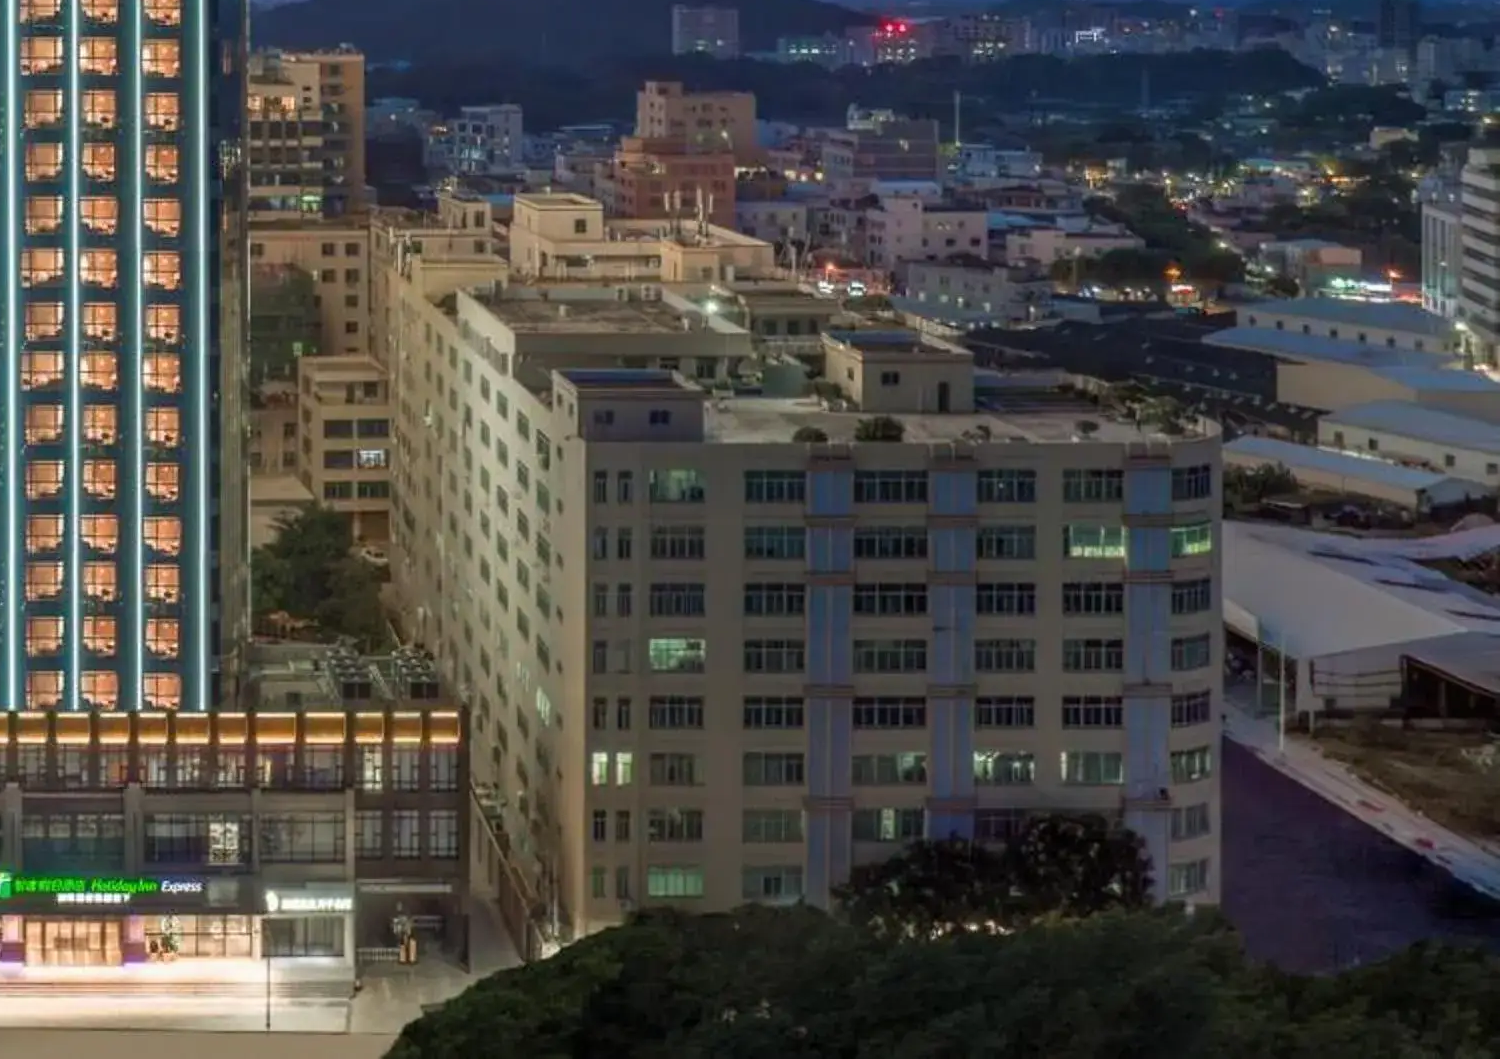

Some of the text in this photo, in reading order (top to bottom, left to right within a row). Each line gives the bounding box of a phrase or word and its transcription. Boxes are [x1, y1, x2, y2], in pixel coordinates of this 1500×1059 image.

[91, 878, 136, 894] Holiday
[138, 878, 158, 891] Inn
[161, 880, 203, 894] Express
